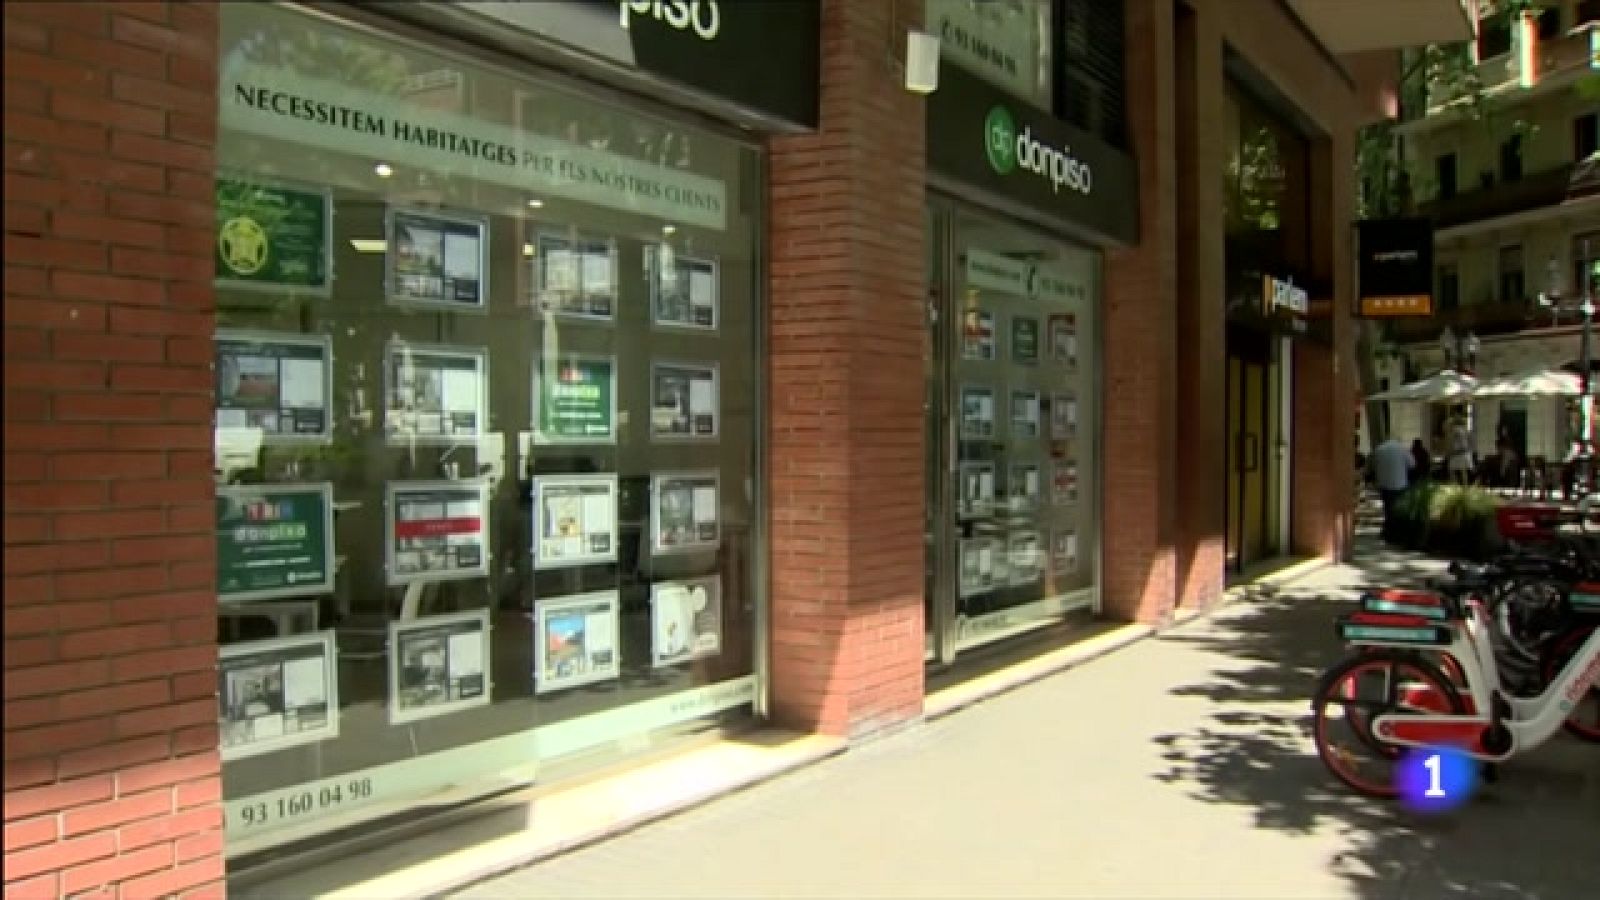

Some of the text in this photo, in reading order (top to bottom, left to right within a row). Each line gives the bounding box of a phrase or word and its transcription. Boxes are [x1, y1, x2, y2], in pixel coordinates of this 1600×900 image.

[234, 84, 386, 136] NECESSITEM
[394, 119, 516, 166] HABITATGES
[523, 150, 553, 175] PER
[1017, 124, 1091, 195] donpiso
[241, 778, 372, 826] 93 160 04 98
